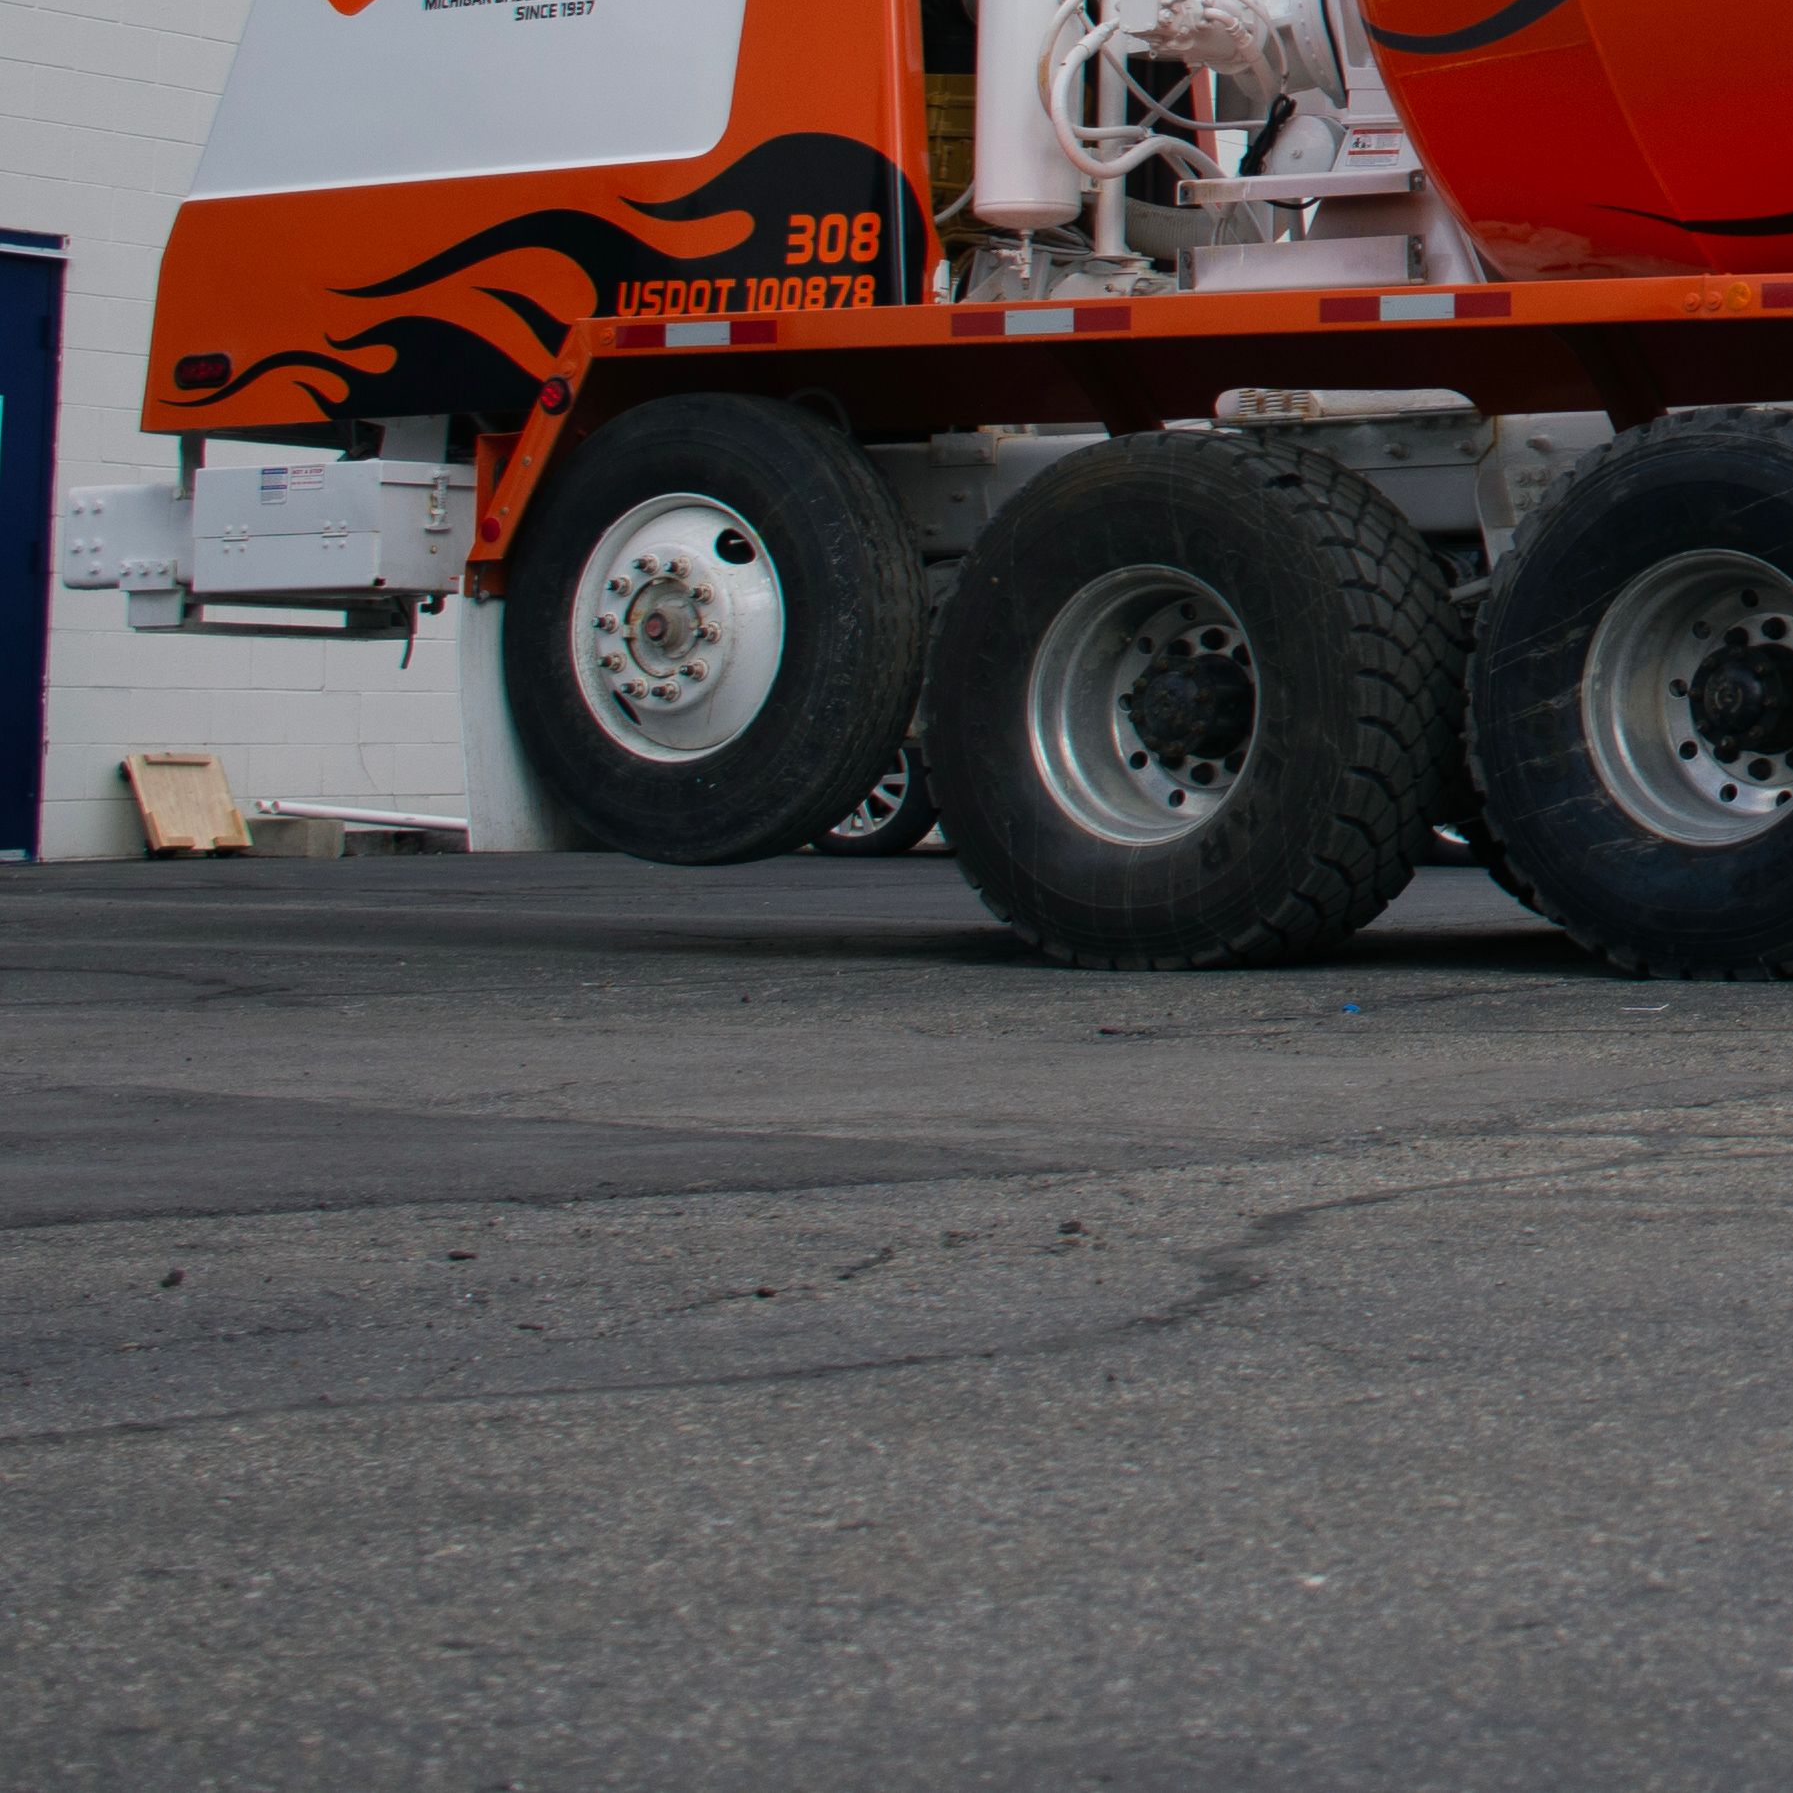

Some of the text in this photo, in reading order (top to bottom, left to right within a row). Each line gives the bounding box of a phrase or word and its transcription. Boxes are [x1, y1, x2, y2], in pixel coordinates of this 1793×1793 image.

[514, 0, 596, 21] SINCE 1937
[786, 212, 881, 265] 308
[617, 275, 876, 317] USDOT 100878
